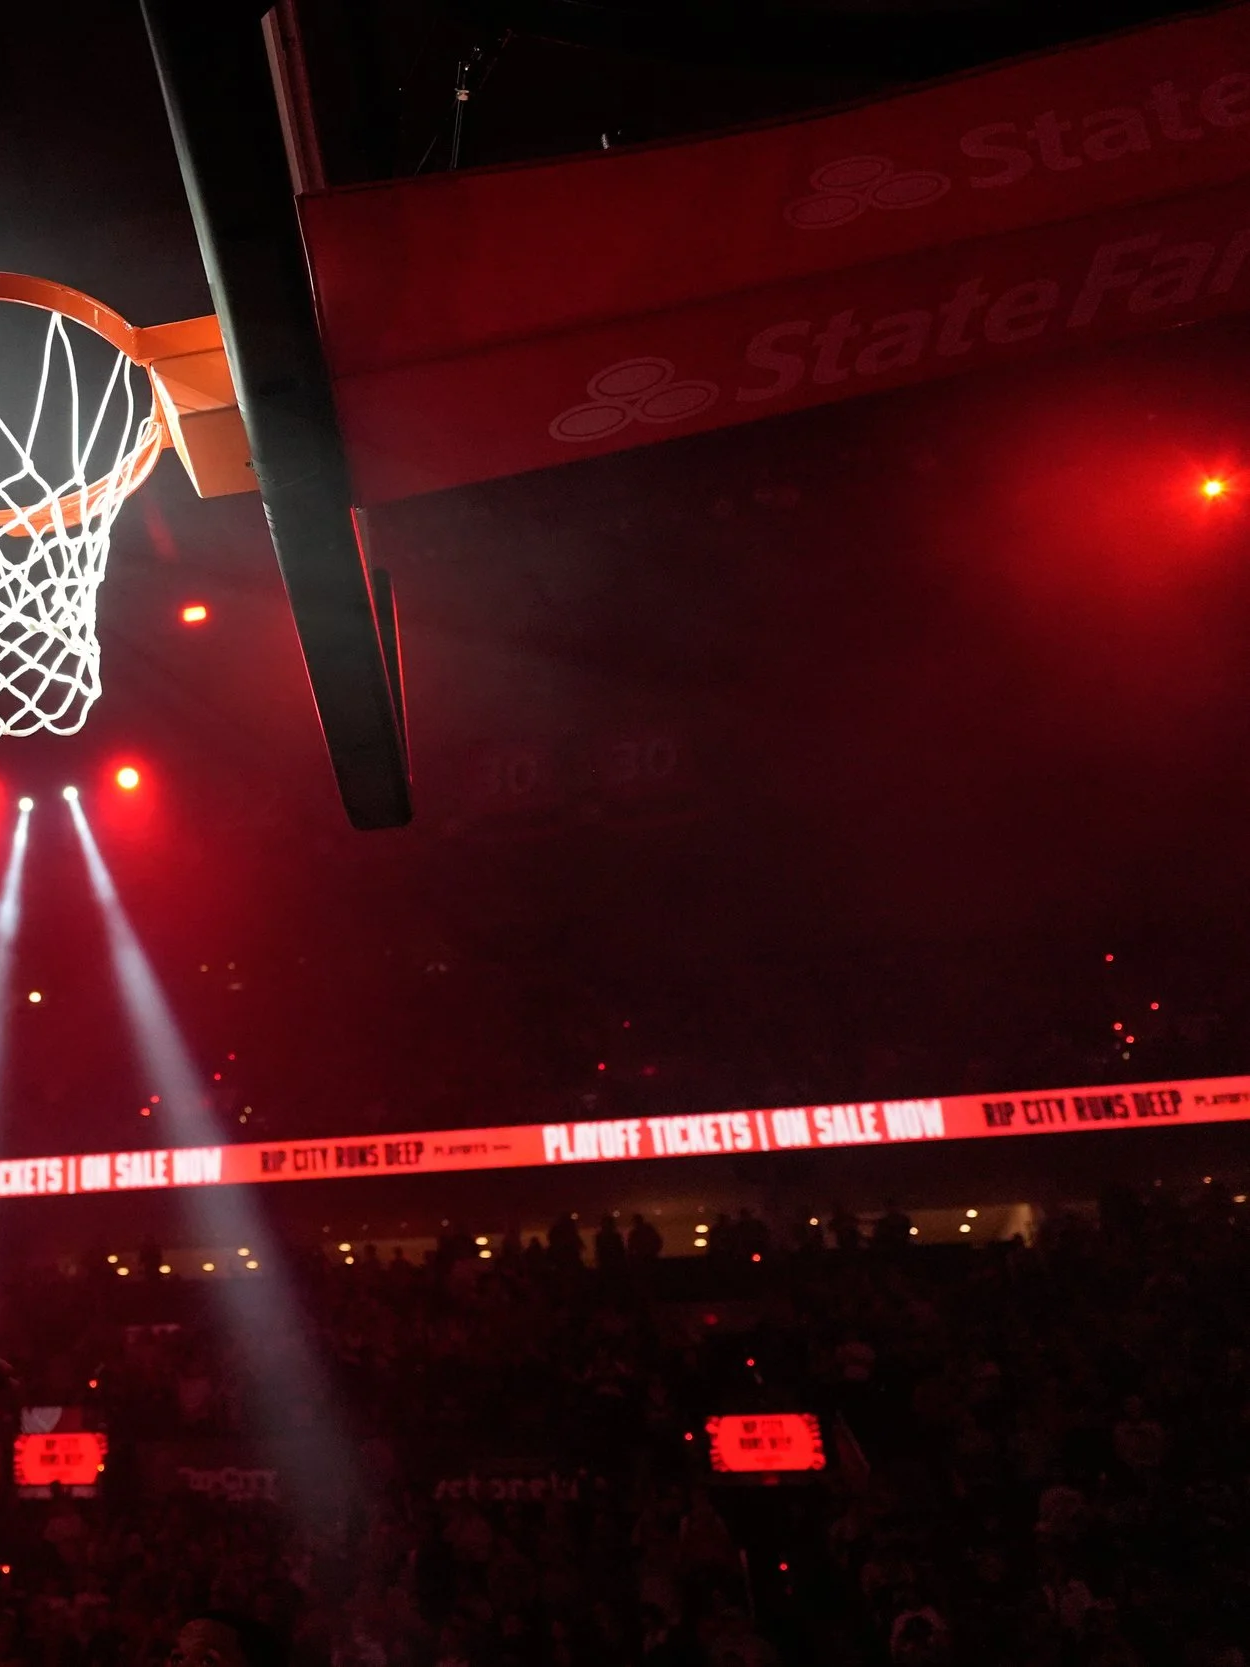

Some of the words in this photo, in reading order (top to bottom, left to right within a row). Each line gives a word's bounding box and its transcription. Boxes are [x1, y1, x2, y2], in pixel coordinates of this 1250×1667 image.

[958, 71, 1250, 189] State
[981, 1101, 1016, 1128] RIP
[1021, 1098, 1067, 1126] CITY
[1072, 1093, 1131, 1122] RUNS
[1129, 1089, 1183, 1119] DEEP
[542, 1118, 642, 1164] PLAYOFF
[647, 1111, 752, 1157] TICKETS
[772, 1106, 812, 1148] ON
[813, 1102, 883, 1146] SALE
[881, 1098, 946, 1139] NOW
[80, 1153, 111, 1190] ON
[115, 1149, 168, 1187] SALE
[172, 1146, 222, 1185] NOW
[261, 1149, 286, 1173] RIP
[293, 1147, 328, 1172] CITY
[335, 1143, 379, 1169] RUNS
[384, 1140, 424, 1167] DEEP
